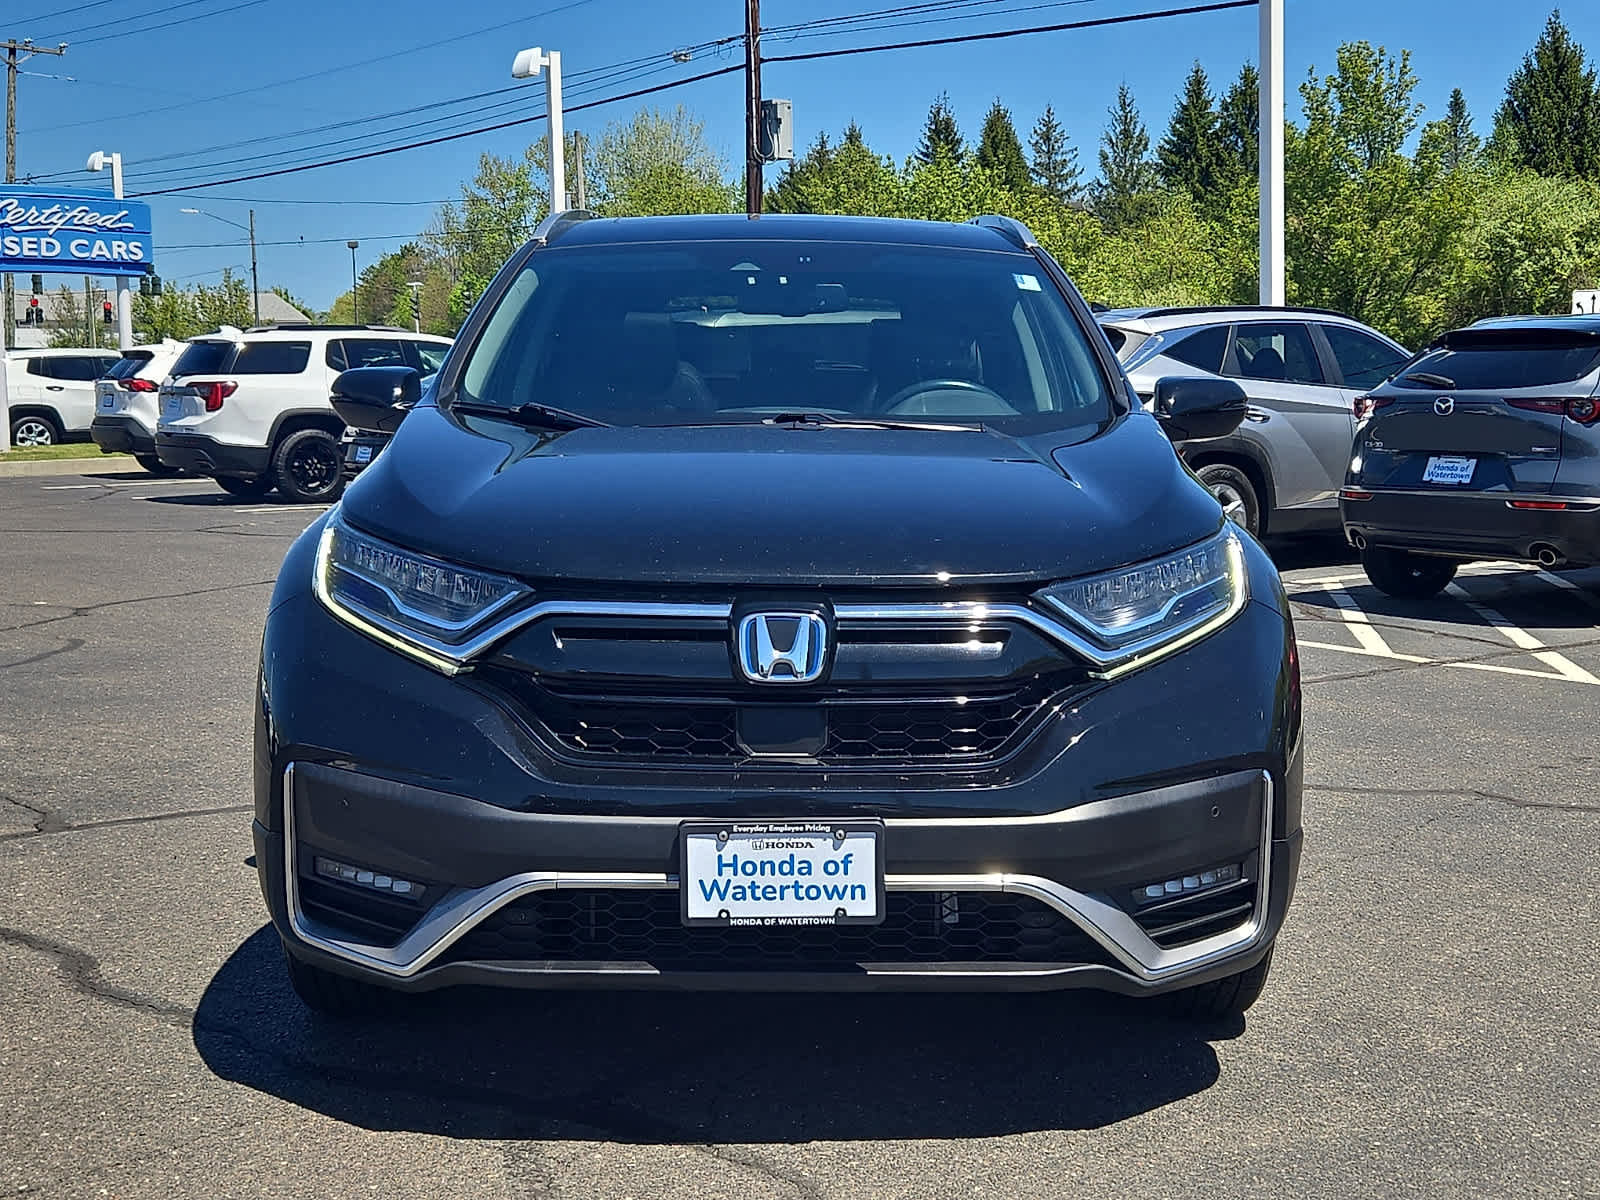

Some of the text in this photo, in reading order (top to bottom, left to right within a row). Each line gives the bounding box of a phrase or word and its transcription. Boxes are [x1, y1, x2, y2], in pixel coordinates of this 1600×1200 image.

[0, 199, 134, 235] Certified
[0, 235, 144, 261] SED CARS
[1433, 463, 1458, 472] Honda
[1427, 470, 1470, 479] Watertown
[732, 824, 831, 833] Everyday Employee Pricing
[765, 841, 815, 849] HONDA
[717, 853, 853, 877] Honda of
[698, 879, 866, 901] Watertown
[730, 918, 762, 926] HONDA
[778, 917, 835, 926] WATERTOWN
